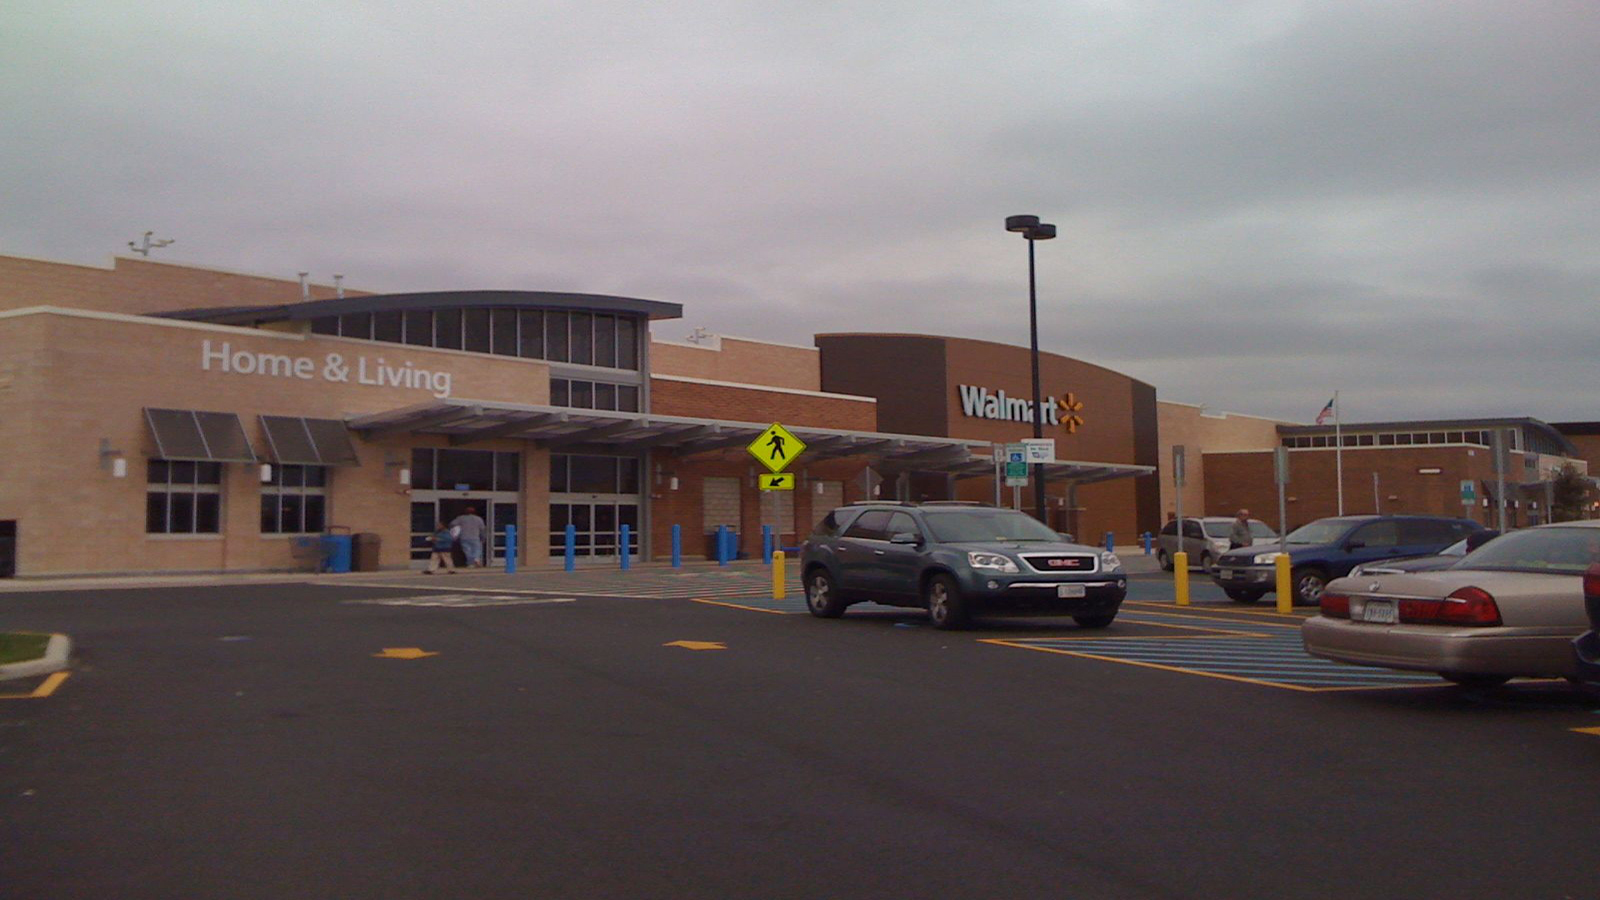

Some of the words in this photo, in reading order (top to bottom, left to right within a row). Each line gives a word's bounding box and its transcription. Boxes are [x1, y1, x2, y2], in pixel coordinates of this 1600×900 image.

[203, 339, 314, 379] Home
[322, 352, 349, 382] &
[358, 356, 451, 399] Living
[1047, 559, 1080, 567] GMC
